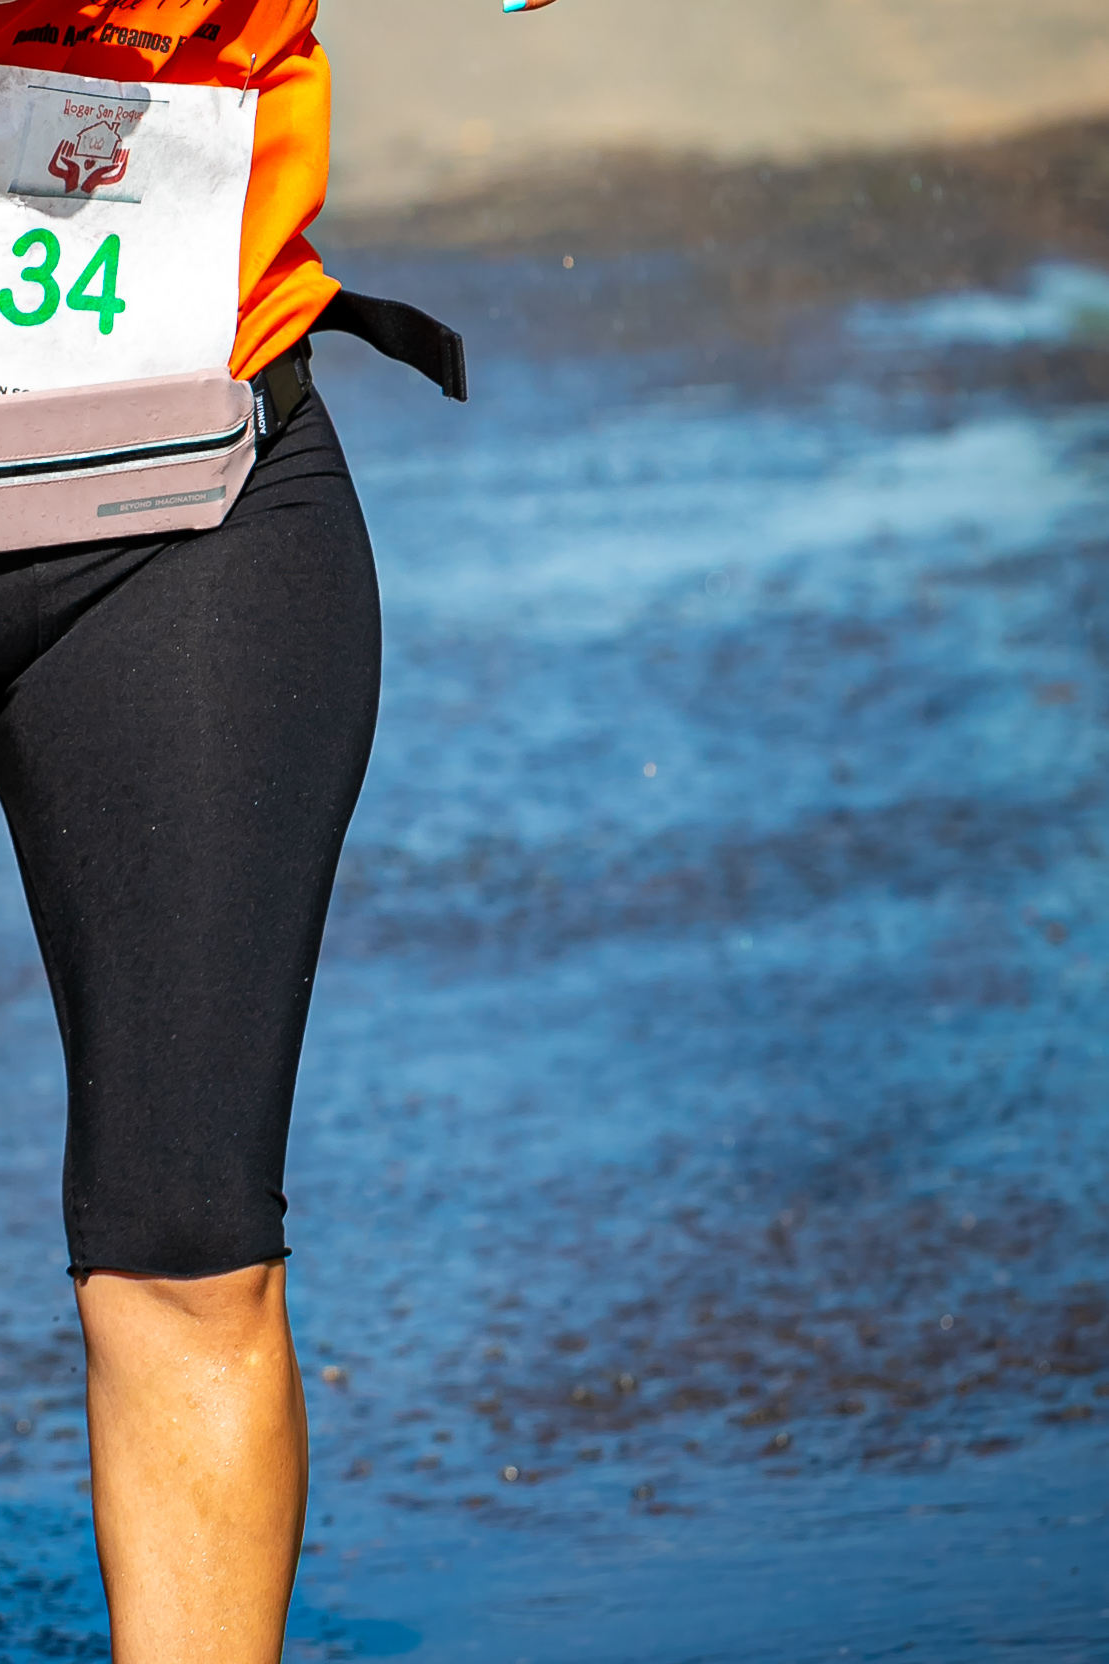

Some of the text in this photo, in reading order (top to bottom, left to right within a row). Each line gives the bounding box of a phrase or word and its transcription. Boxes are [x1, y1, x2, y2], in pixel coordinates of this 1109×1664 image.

[99, 22, 172, 54] Creamos
[63, 99, 144, 122] Hogar San Roque
[119, 493, 207, 512] BEYOND IMAGINATION
